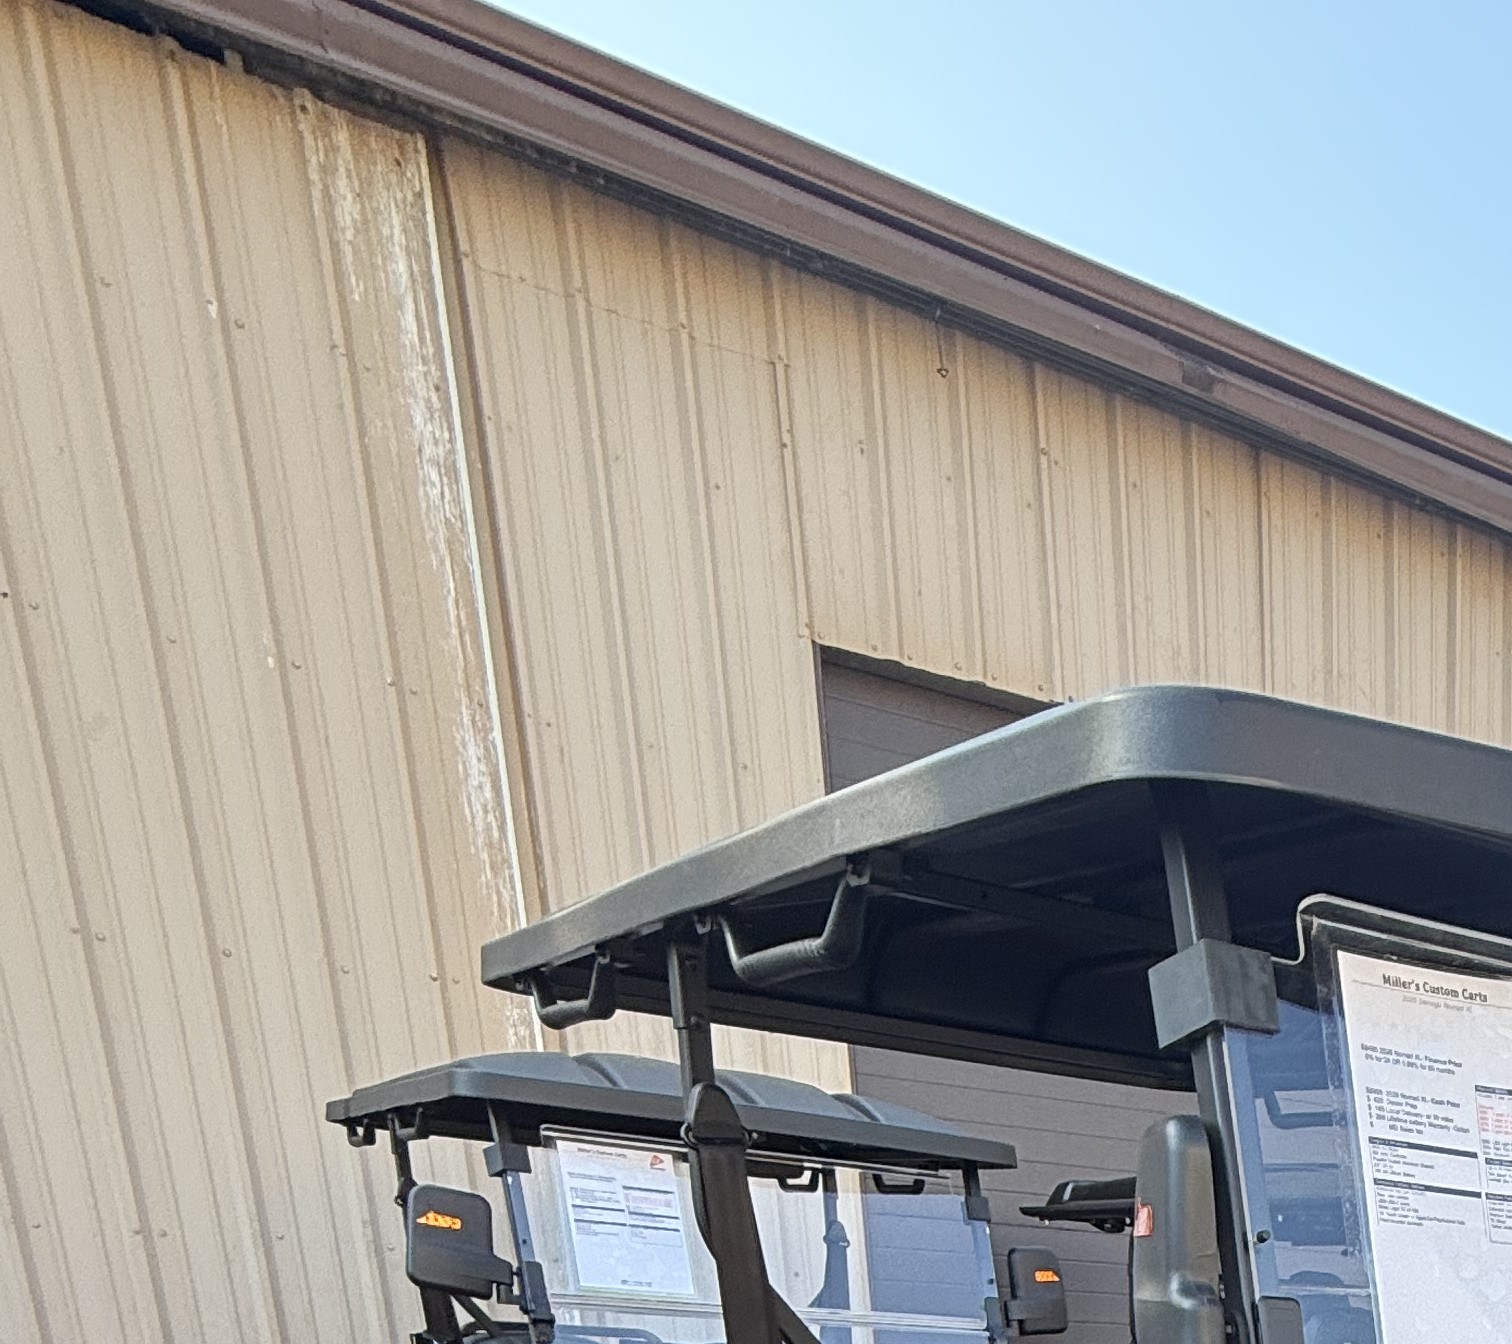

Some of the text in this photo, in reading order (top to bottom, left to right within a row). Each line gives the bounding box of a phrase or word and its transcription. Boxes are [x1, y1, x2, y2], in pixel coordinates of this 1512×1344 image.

[1382, 973, 1488, 1003] Miller's Custom Carts
